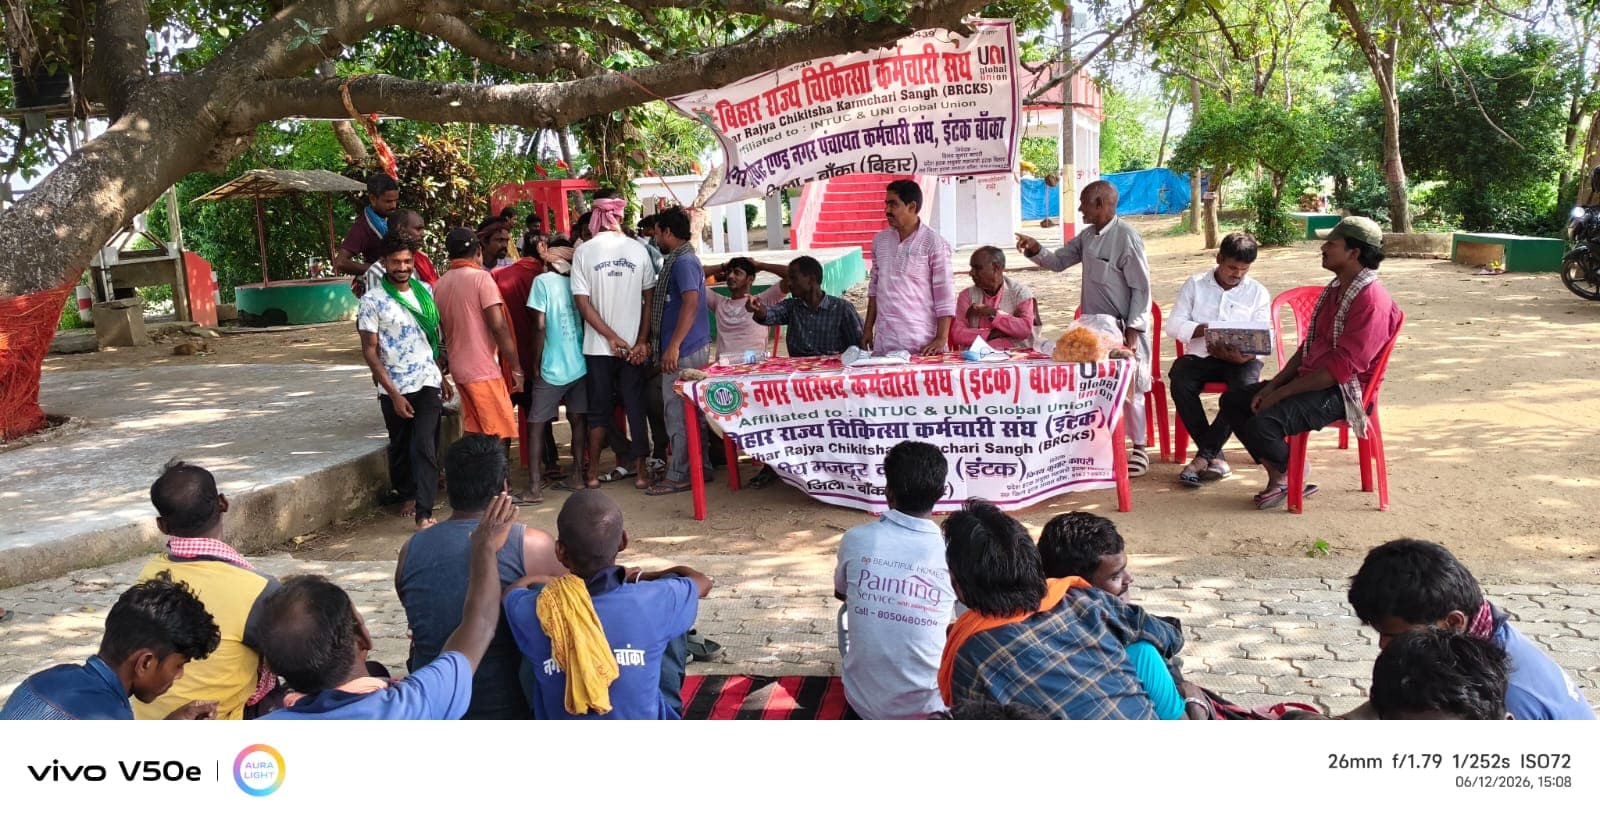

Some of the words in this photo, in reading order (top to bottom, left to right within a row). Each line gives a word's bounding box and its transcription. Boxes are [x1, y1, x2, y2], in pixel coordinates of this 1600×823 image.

[980, 65, 1007, 75] global
[715, 95, 762, 134] बिहार
[762, 80, 802, 116] राज्य
[802, 60, 872, 105] चिकित्सा
[873, 42, 940, 88] कर्मचारी
[744, 122, 777, 140] Rajya
[779, 103, 833, 126] Chikitsha
[837, 93, 897, 112] Karmchari
[900, 86, 938, 102] Sangh
[942, 82, 993, 98] (BRCKS)
[786, 127, 799, 136] to
[810, 114, 851, 130] INTUC
[856, 111, 866, 119] &
[870, 107, 894, 117] UNI
[898, 102, 937, 113] Global
[941, 100, 977, 110] Union
[790, 141, 818, 165] नगर
[817, 130, 860, 156] पंचायत
[862, 118, 910, 148] कर्मचारी
[912, 115, 939, 148] संघ,
[941, 112, 972, 145] इंटक
[860, 152, 918, 175] (बिहार)
[594, 260, 610, 271] नगर
[751, 379, 791, 407] नगर
[1079, 389, 1113, 402] union
[1080, 379, 1118, 391] global
[739, 411, 819, 428] Affiliated
[825, 409, 842, 418] to
[859, 405, 917, 418] INTUC
[924, 406, 937, 416] &
[944, 405, 978, 415] UNI
[985, 404, 1041, 415] Global
[1047, 400, 1093, 413] Union
[777, 423, 825, 441] राज्य
[827, 418, 909, 440] चिकित्सा
[913, 416, 996, 439] कर्मचारी
[1000, 416, 1037, 438] संघ
[1046, 406, 1105, 438] (इंटक)
[752, 450, 781, 462] ihar
[784, 443, 825, 457] Rajya
[829, 443, 891, 455] Chikitsha
[940, 442, 979, 454] chari
[984, 443, 1033, 457] Sangh
[1038, 429, 1095, 454] (BRCKS)
[811, 461, 868, 482] मजदूर
[956, 456, 1026, 482] (इंटक)
[807, 479, 845, 491] जिला
[856, 482, 886, 496] बाँक
[873, 557, 914, 571] BEAUTIFUL
[917, 566, 945, 580] HOMES
[858, 569, 941, 606] Painting
[858, 590, 895, 605] Service
[855, 606, 869, 616] Call
[878, 610, 938, 627] 8050480504
[543, 658, 562, 676] नग
[613, 643, 647, 666] बांका
